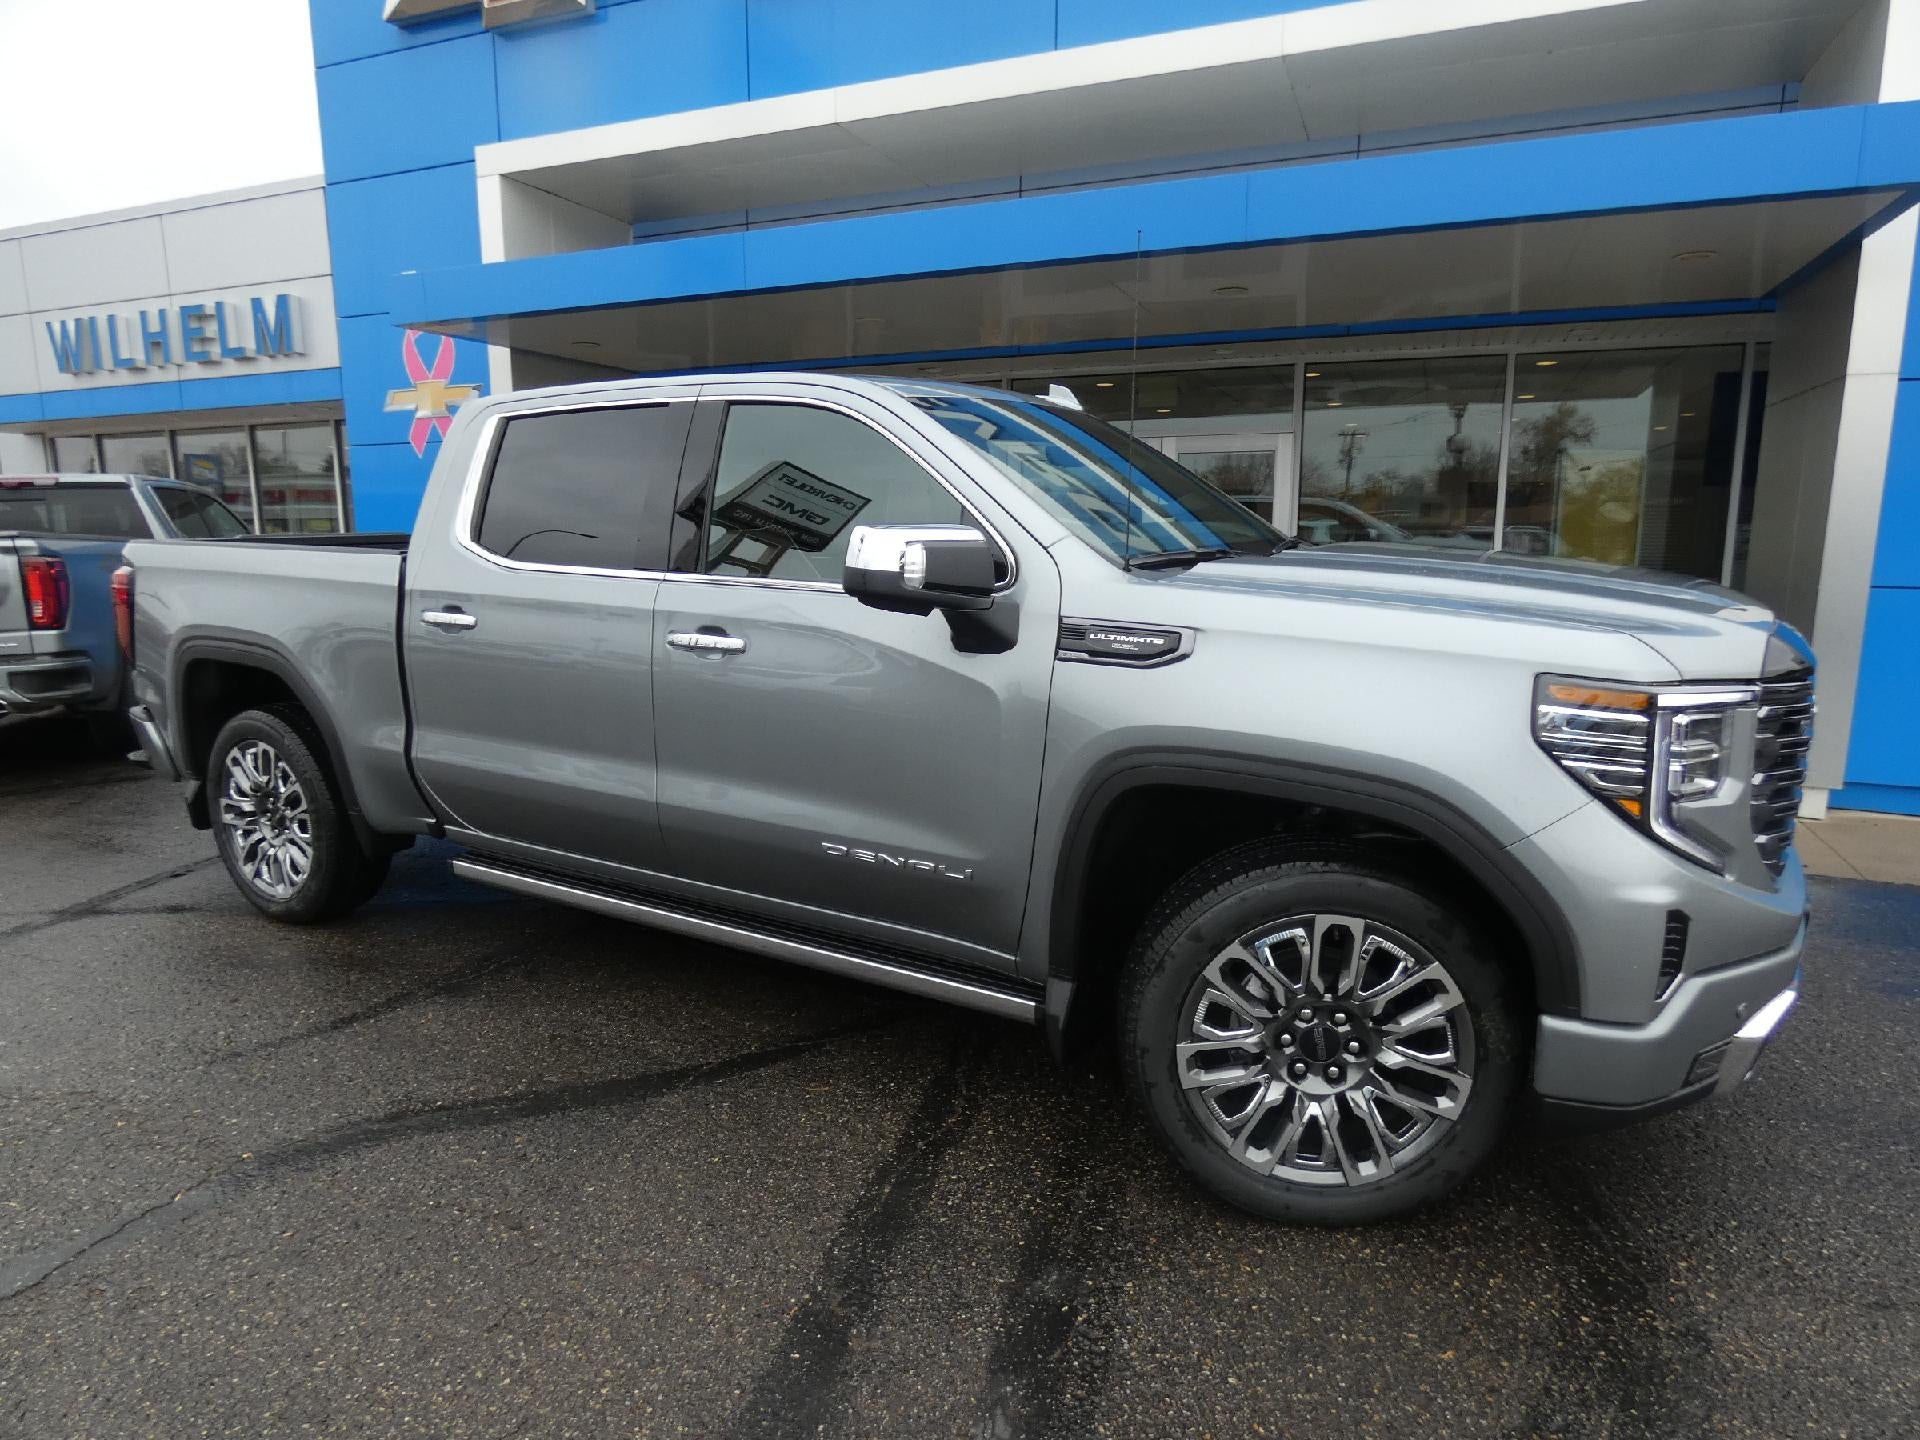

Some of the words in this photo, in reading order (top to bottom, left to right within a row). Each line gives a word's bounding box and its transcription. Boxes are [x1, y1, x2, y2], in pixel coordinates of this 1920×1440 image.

[45, 293, 300, 375] WILHELM
[1089, 633, 1165, 645] ULTIMATE
[821, 842, 973, 881] DENALI
